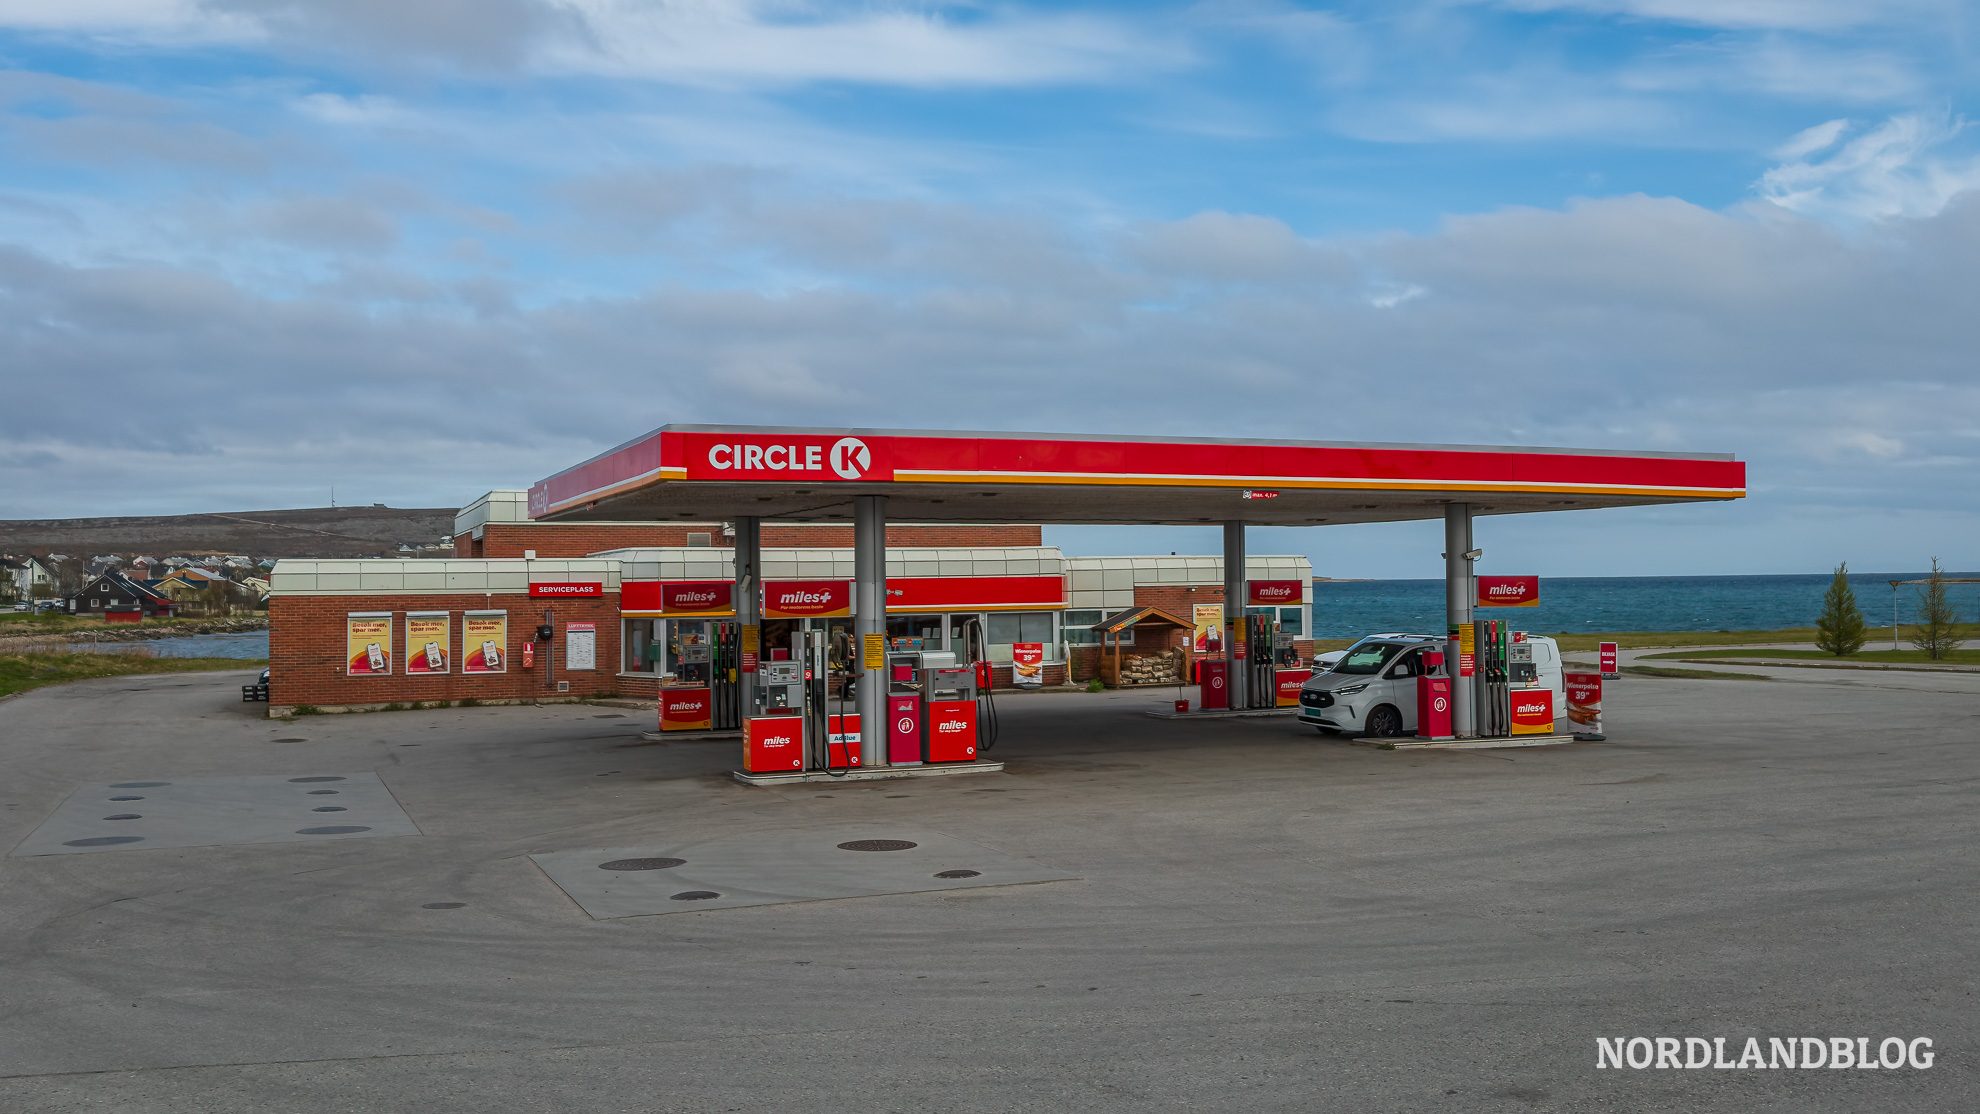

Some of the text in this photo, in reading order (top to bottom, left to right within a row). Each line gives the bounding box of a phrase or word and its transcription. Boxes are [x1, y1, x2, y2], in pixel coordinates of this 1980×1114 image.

[708, 441, 870, 478] CIRCLE K
[939, 720, 968, 730] miles
[764, 736, 791, 745] miles
